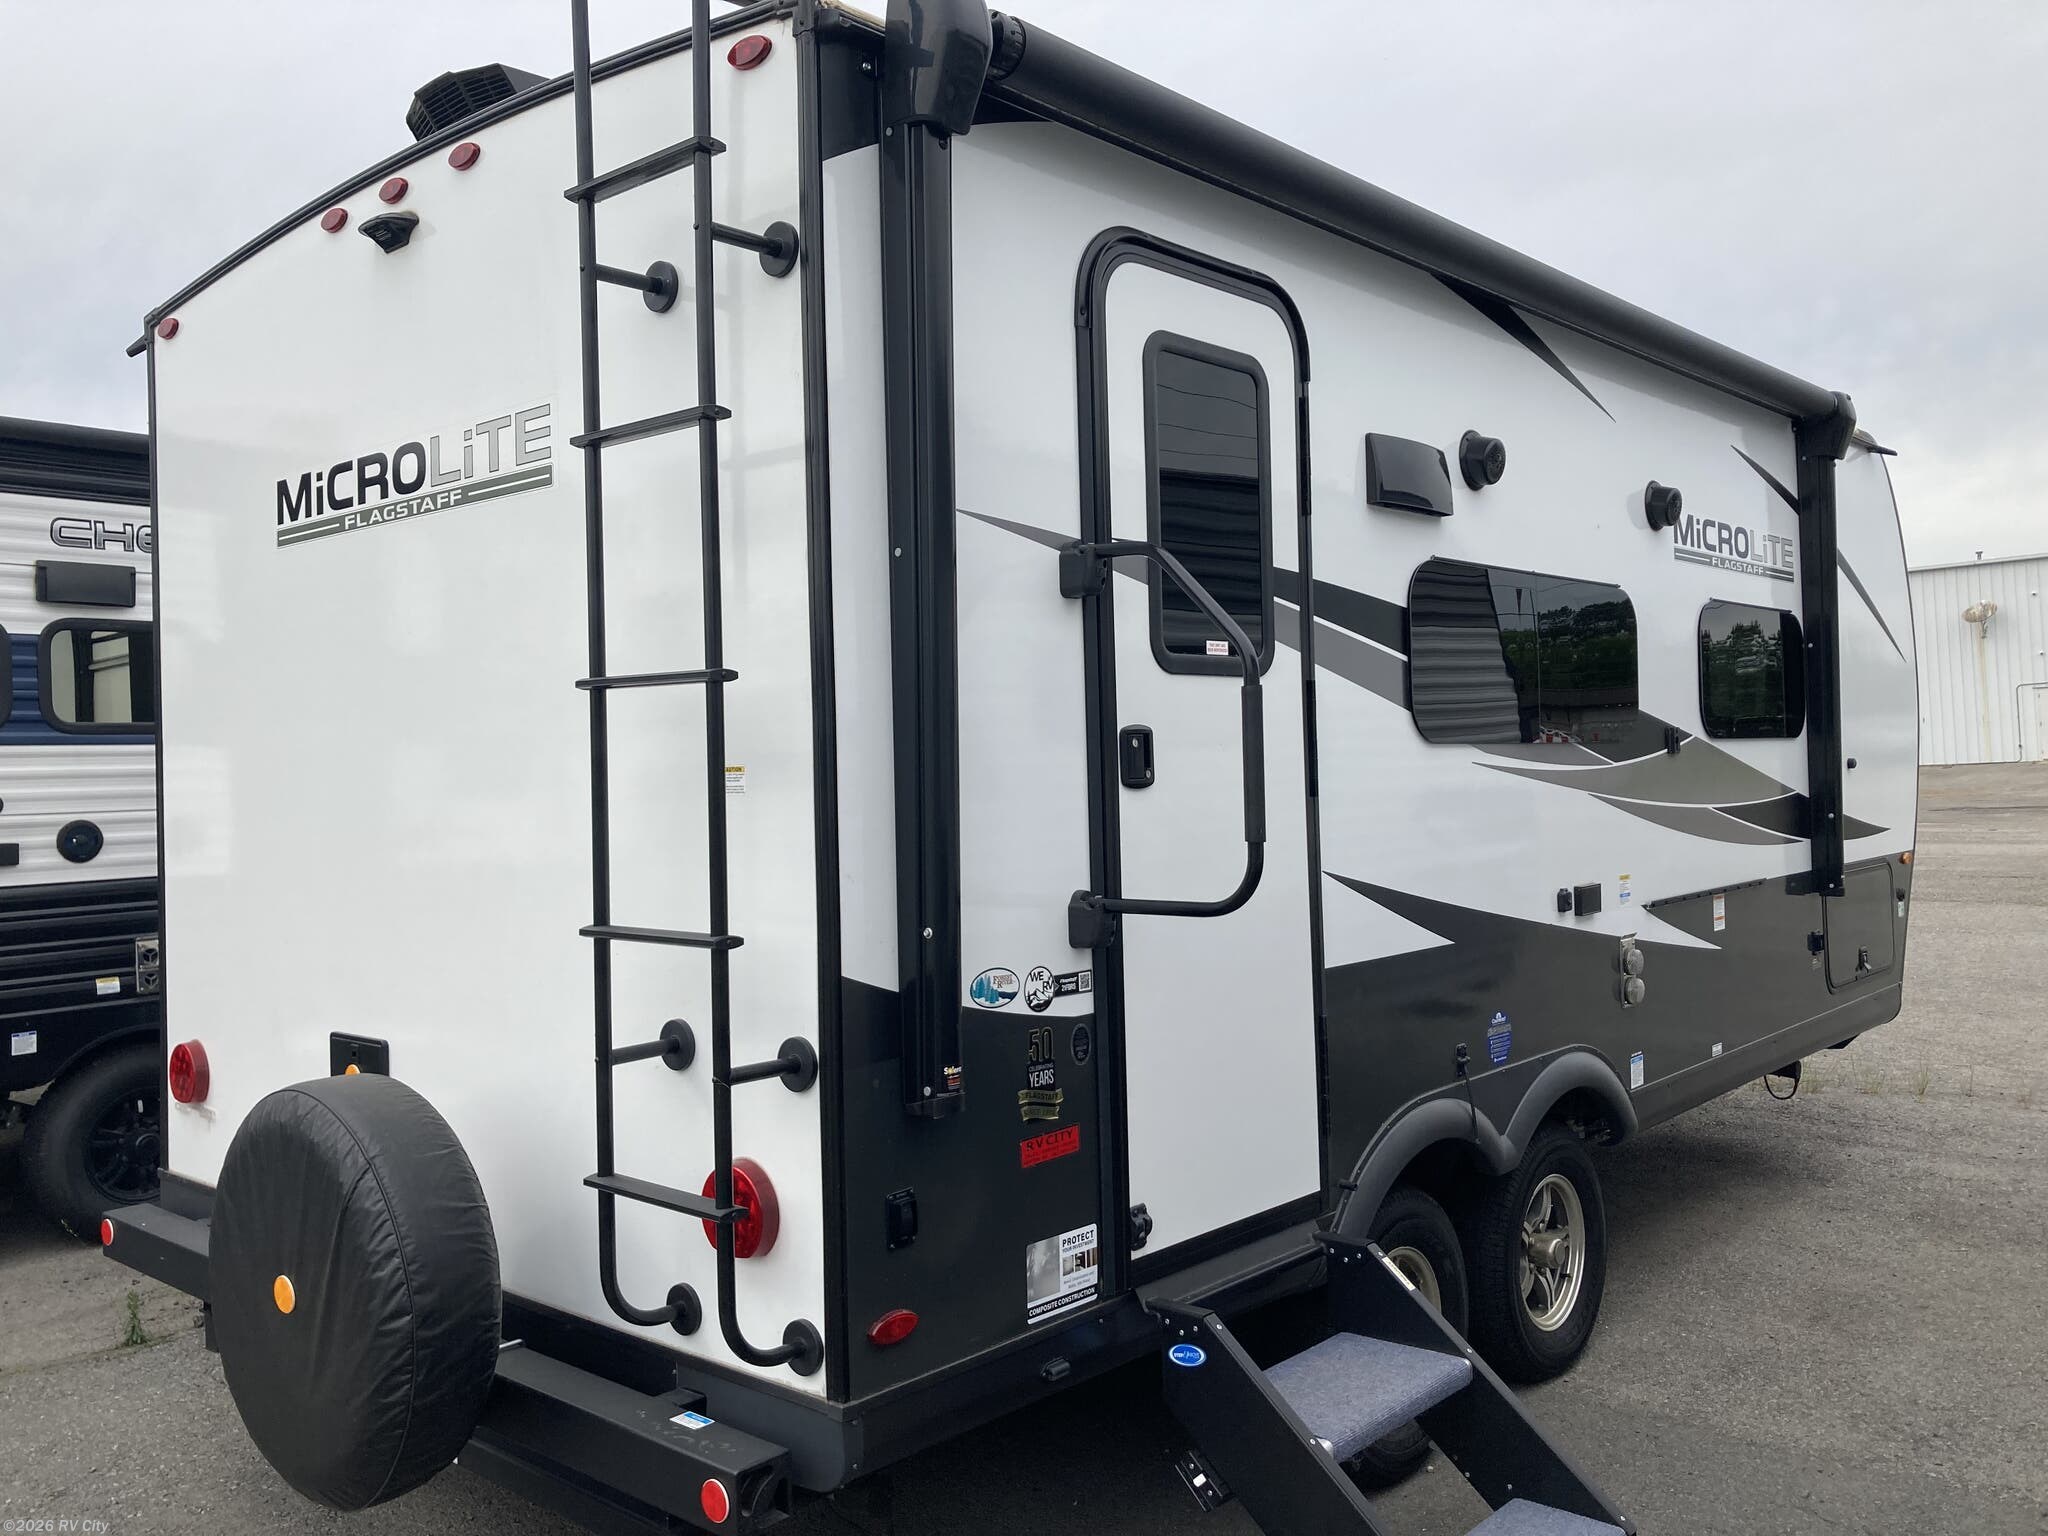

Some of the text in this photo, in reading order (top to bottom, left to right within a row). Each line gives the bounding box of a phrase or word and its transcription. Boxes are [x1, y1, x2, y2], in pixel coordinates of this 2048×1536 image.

[344, 489, 462, 531] FLAGSTAFF
[1711, 556, 1764, 577] FLAGSTAFF
[1030, 970, 1044, 982] WE
[1028, 1026, 1055, 1061] 50
[1028, 1068, 1055, 1088] YEARS
[1045, 1129, 1073, 1145] CITY
[1062, 1230, 1094, 1247] PROTECT
[1028, 1287, 1095, 1316] COMPOSITE CONSTRUCTION
